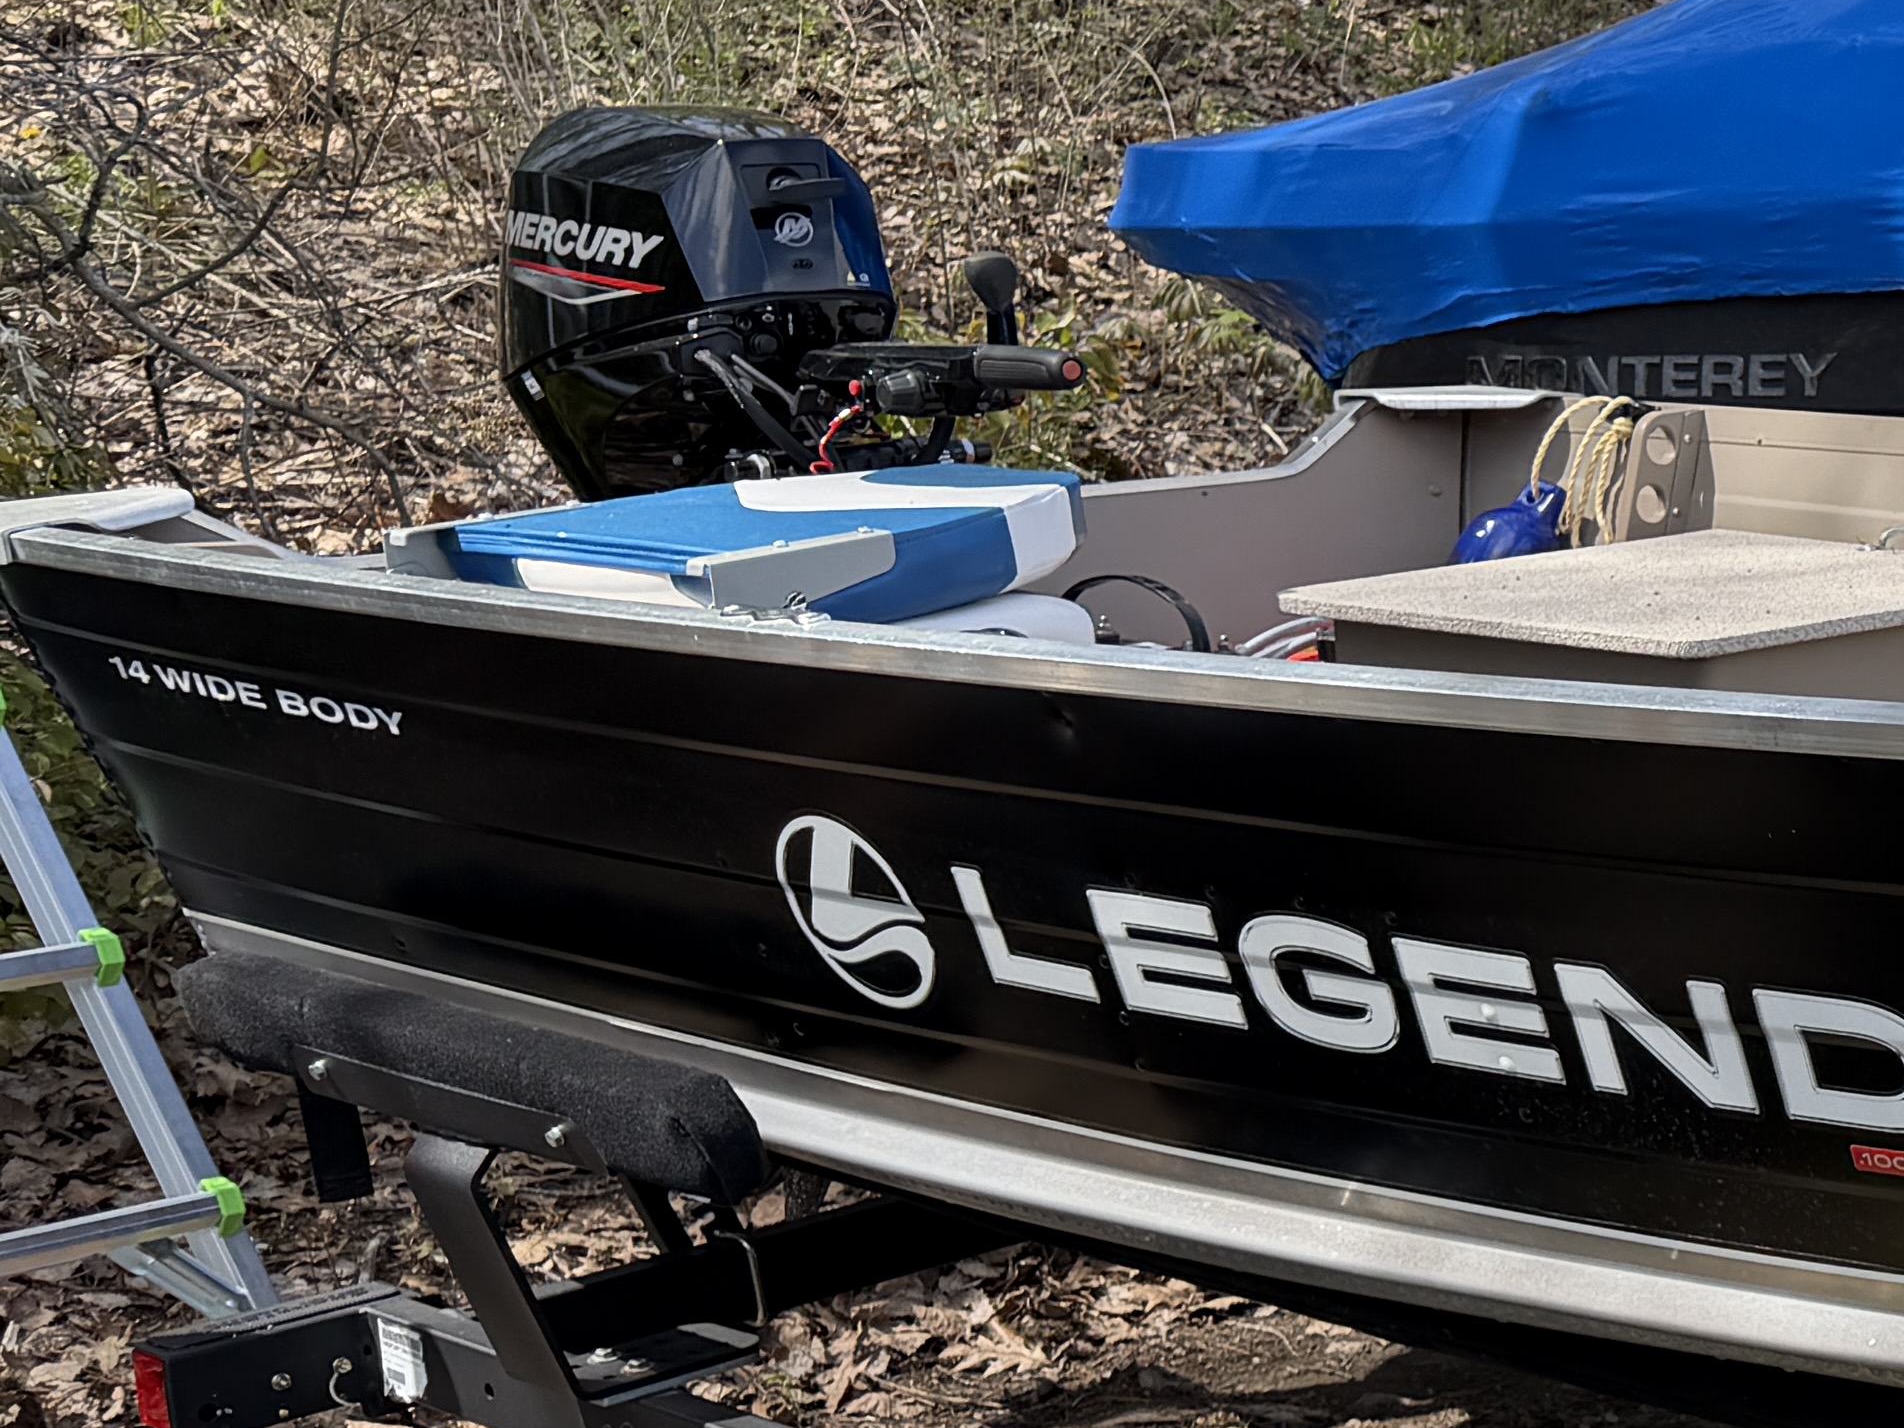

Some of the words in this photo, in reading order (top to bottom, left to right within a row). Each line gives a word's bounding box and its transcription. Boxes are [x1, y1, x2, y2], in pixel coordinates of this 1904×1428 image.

[504, 209, 664, 270] MERCURY
[1465, 351, 1838, 398] MONTEREY
[108, 656, 151, 685] 14
[152, 663, 268, 711] WIDE
[276, 687, 404, 737] BODY
